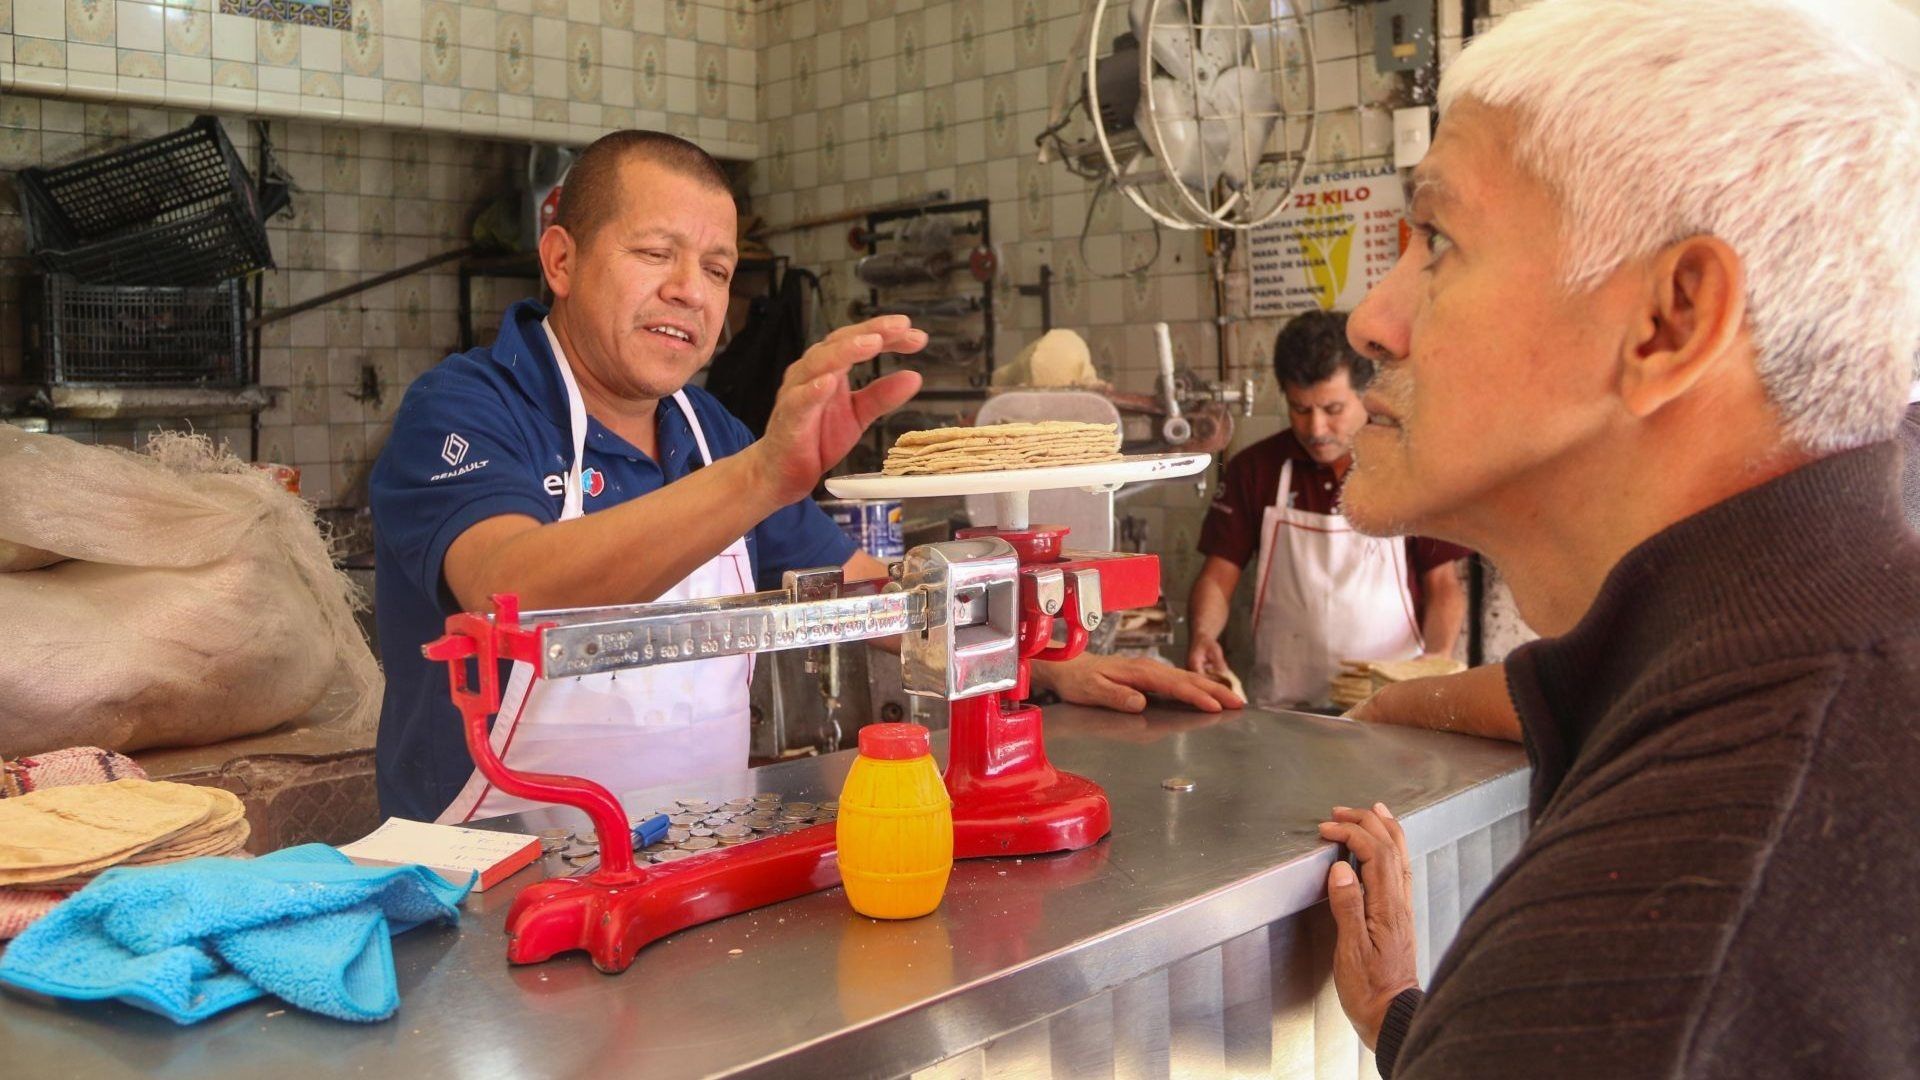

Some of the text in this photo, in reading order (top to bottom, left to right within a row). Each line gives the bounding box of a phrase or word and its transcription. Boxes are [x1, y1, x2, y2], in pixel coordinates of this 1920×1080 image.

[1303, 175, 1321, 185] DE
[1325, 164, 1396, 182] TORTILLAS
[1295, 186, 1370, 207] 22 KILO
[1295, 218, 1315, 227] POR
[1318, 213, 1354, 224] CIENTO
[1252, 235, 1281, 245] SOPES
[1284, 233, 1304, 241] POR
[1306, 228, 1348, 239] DOCENA
[1252, 249, 1279, 258] MASA
[1287, 246, 1309, 255] KILO
[1253, 262, 1278, 272] VASO
[1281, 261, 1294, 269] DE
[1296, 257, 1326, 267] SALSA
[1254, 276, 1285, 286] BOLSA
[1254, 289, 1283, 299] PAPEL
[1286, 286, 1326, 297] GRANDE
[1254, 303, 1283, 311] PAPEL
[430, 459, 490, 482] RENAULT
[543, 471, 569, 496] el
[660, 644, 679, 658] 500
[700, 639, 718, 653] 500
[737, 633, 756, 648] 500
